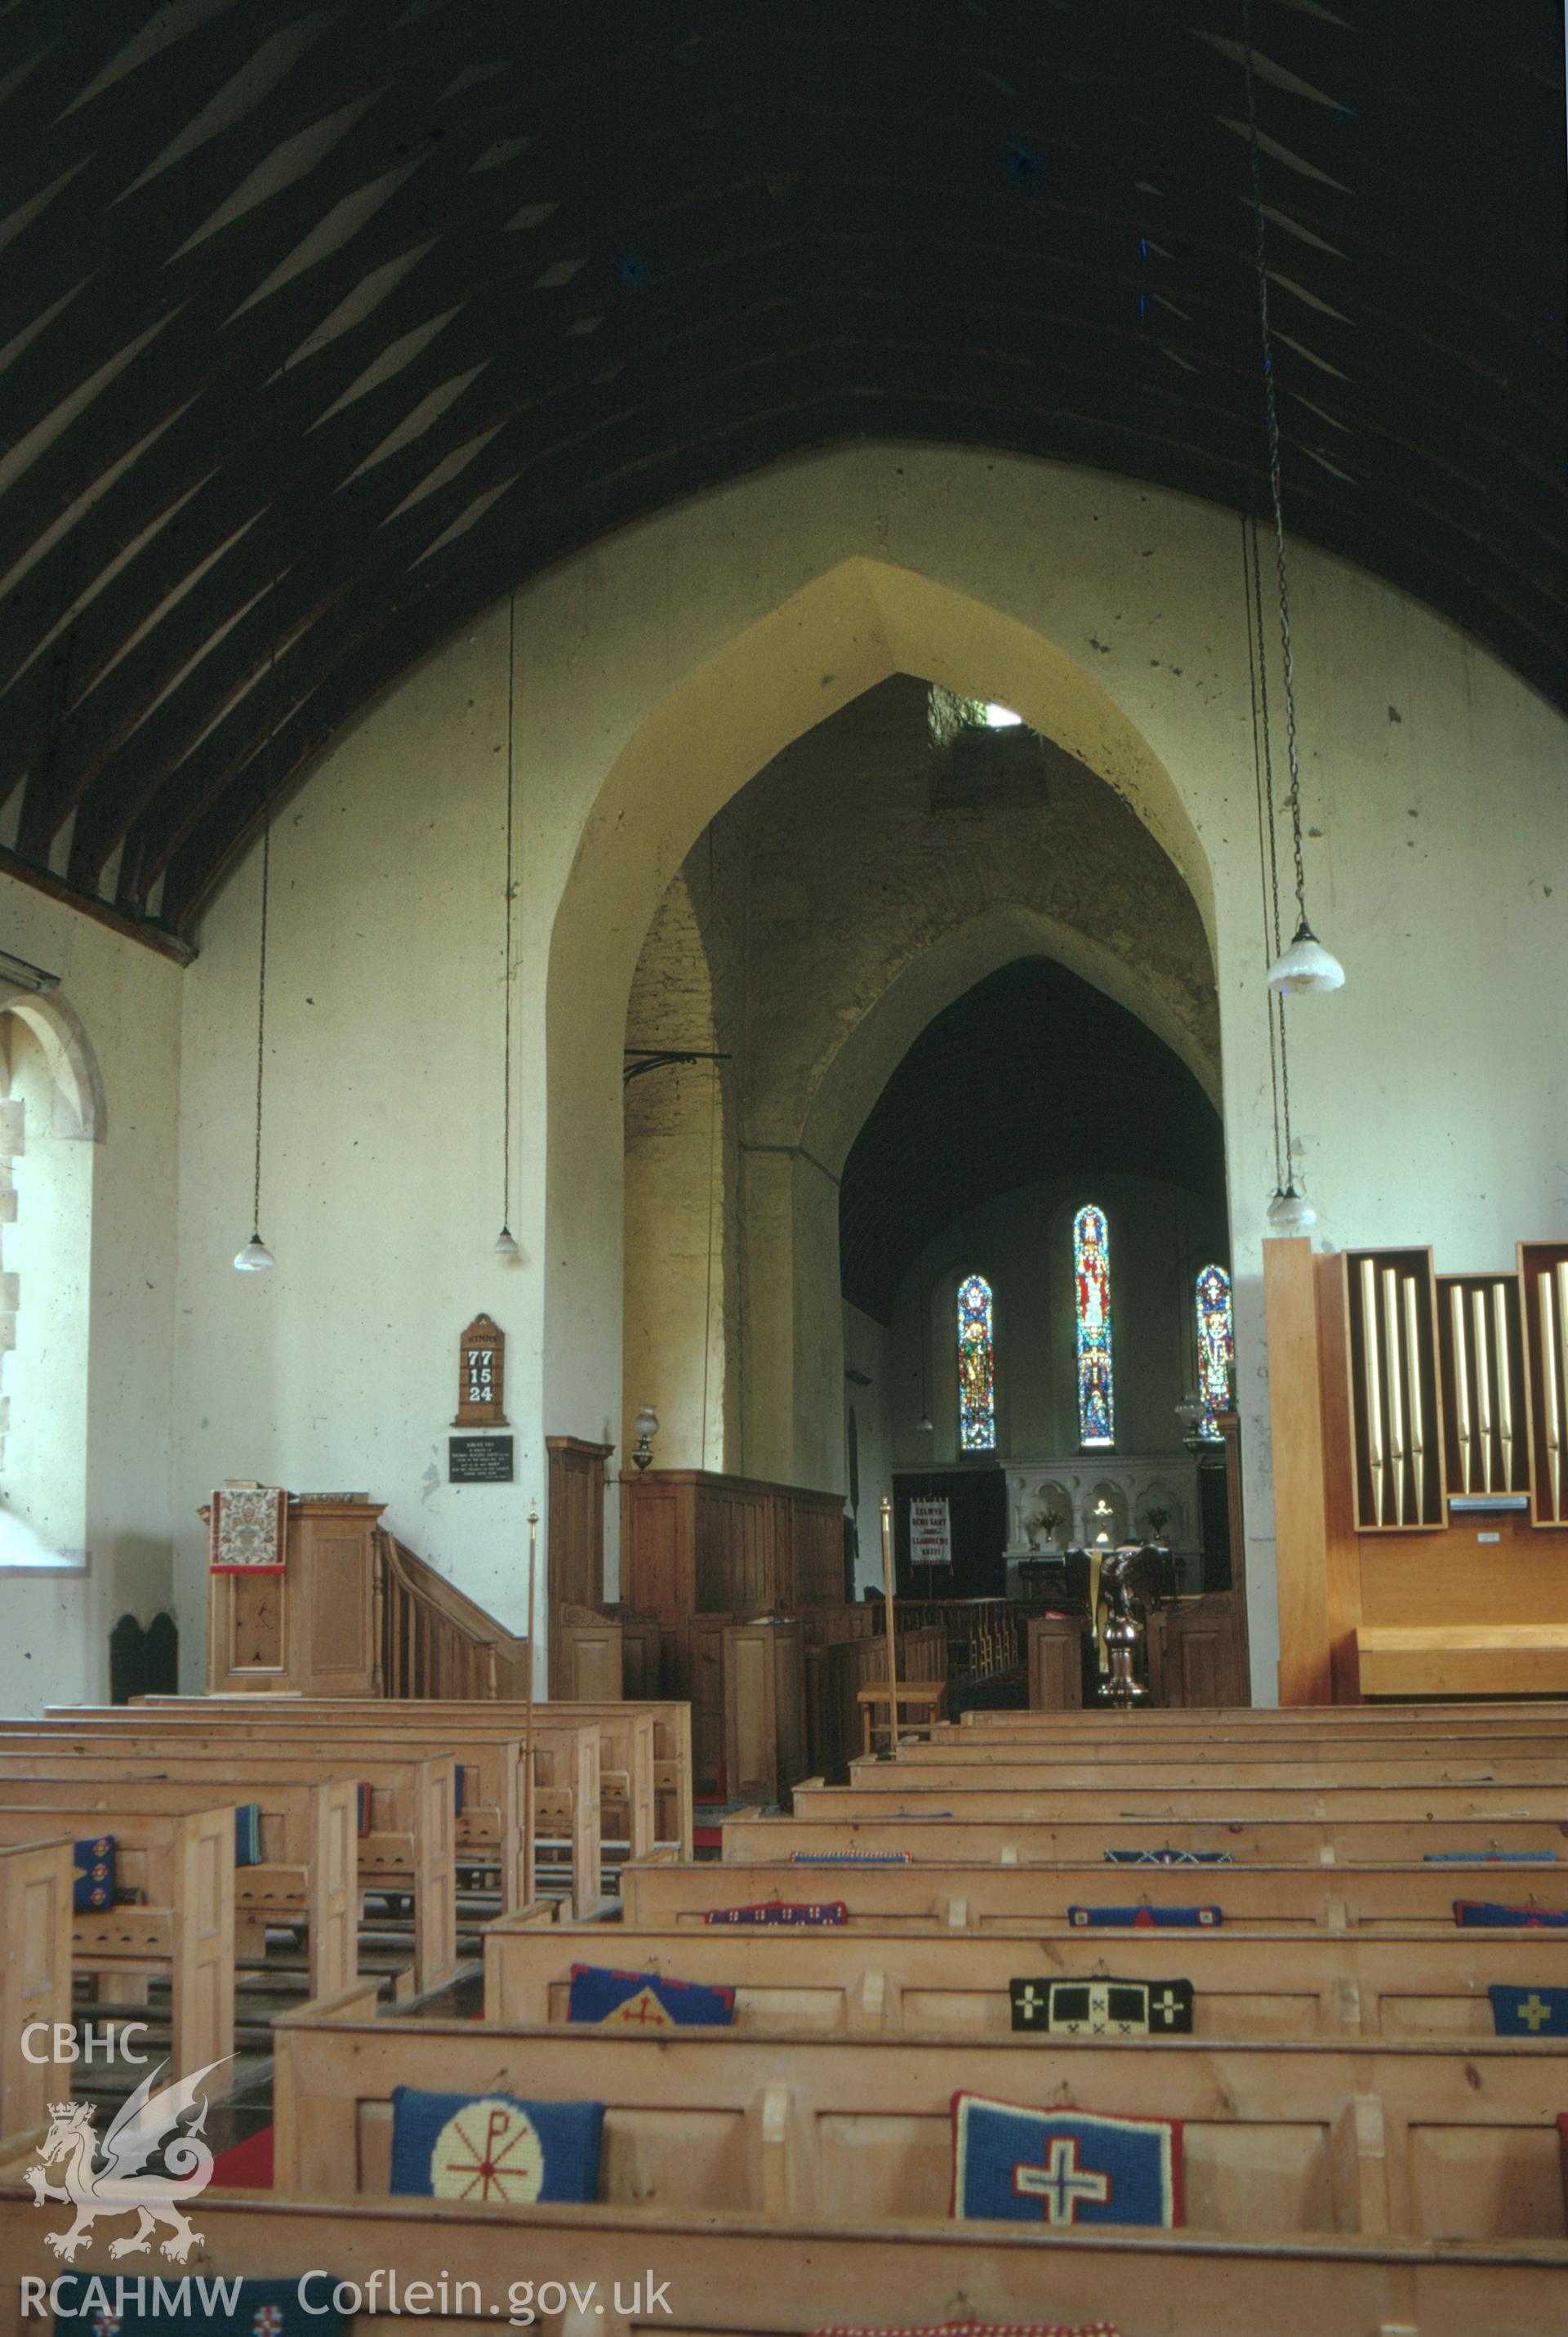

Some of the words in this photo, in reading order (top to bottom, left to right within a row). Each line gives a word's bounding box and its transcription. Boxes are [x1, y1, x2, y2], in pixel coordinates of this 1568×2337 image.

[468, 1350, 492, 1366] 77
[470, 1368, 492, 1384] 15
[470, 1386, 493, 1402] 24
